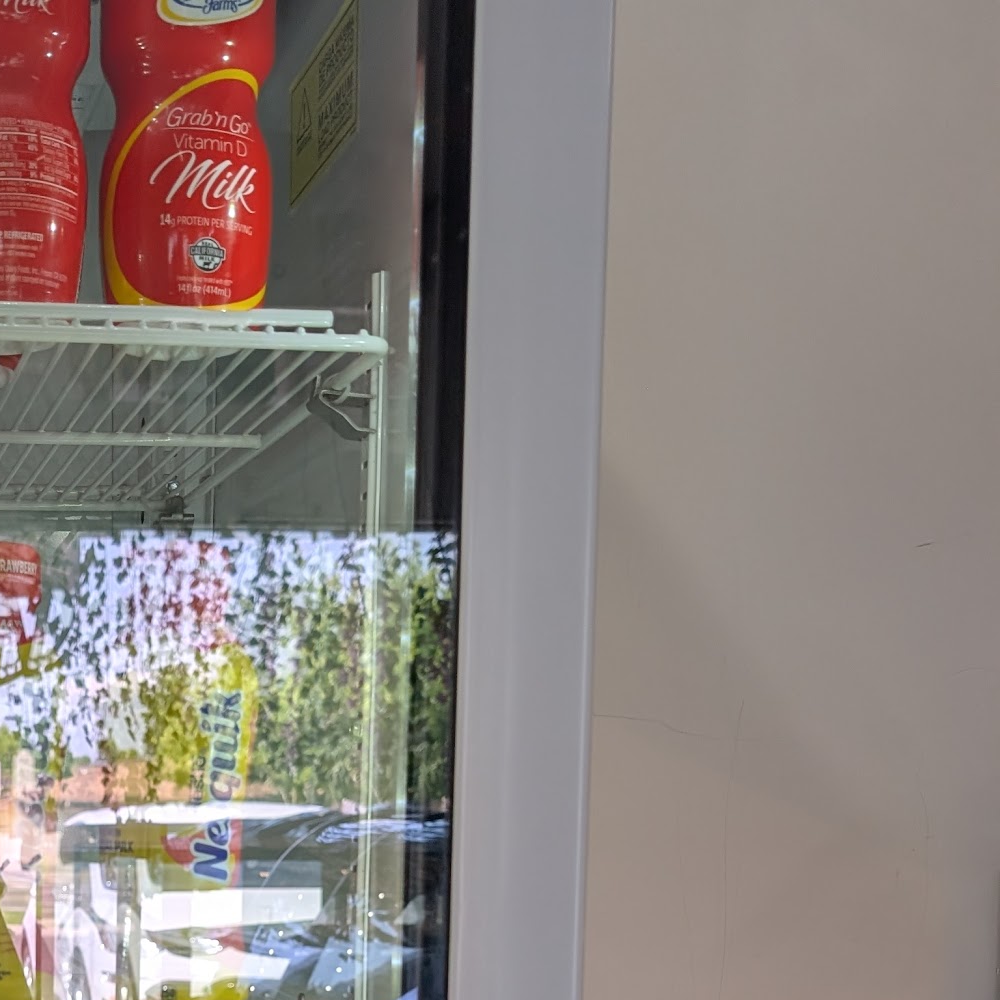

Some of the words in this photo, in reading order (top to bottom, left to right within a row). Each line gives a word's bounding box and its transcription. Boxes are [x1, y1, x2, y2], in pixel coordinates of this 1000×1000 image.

[166, 106, 227, 128] Grab'n
[230, 114, 249, 135] Go
[173, 133, 233, 154] Vitamin
[236, 140, 248, 157] D
[149, 150, 257, 214] Milk
[160, 213, 176, 228] 14g
[177, 215, 210, 227] PROTEIN
[211, 217, 224, 228] PER
[225, 220, 253, 236] SERVING
[190, 246, 223, 258] CALIFORNIA
[194, 692, 242, 882] Nequik
